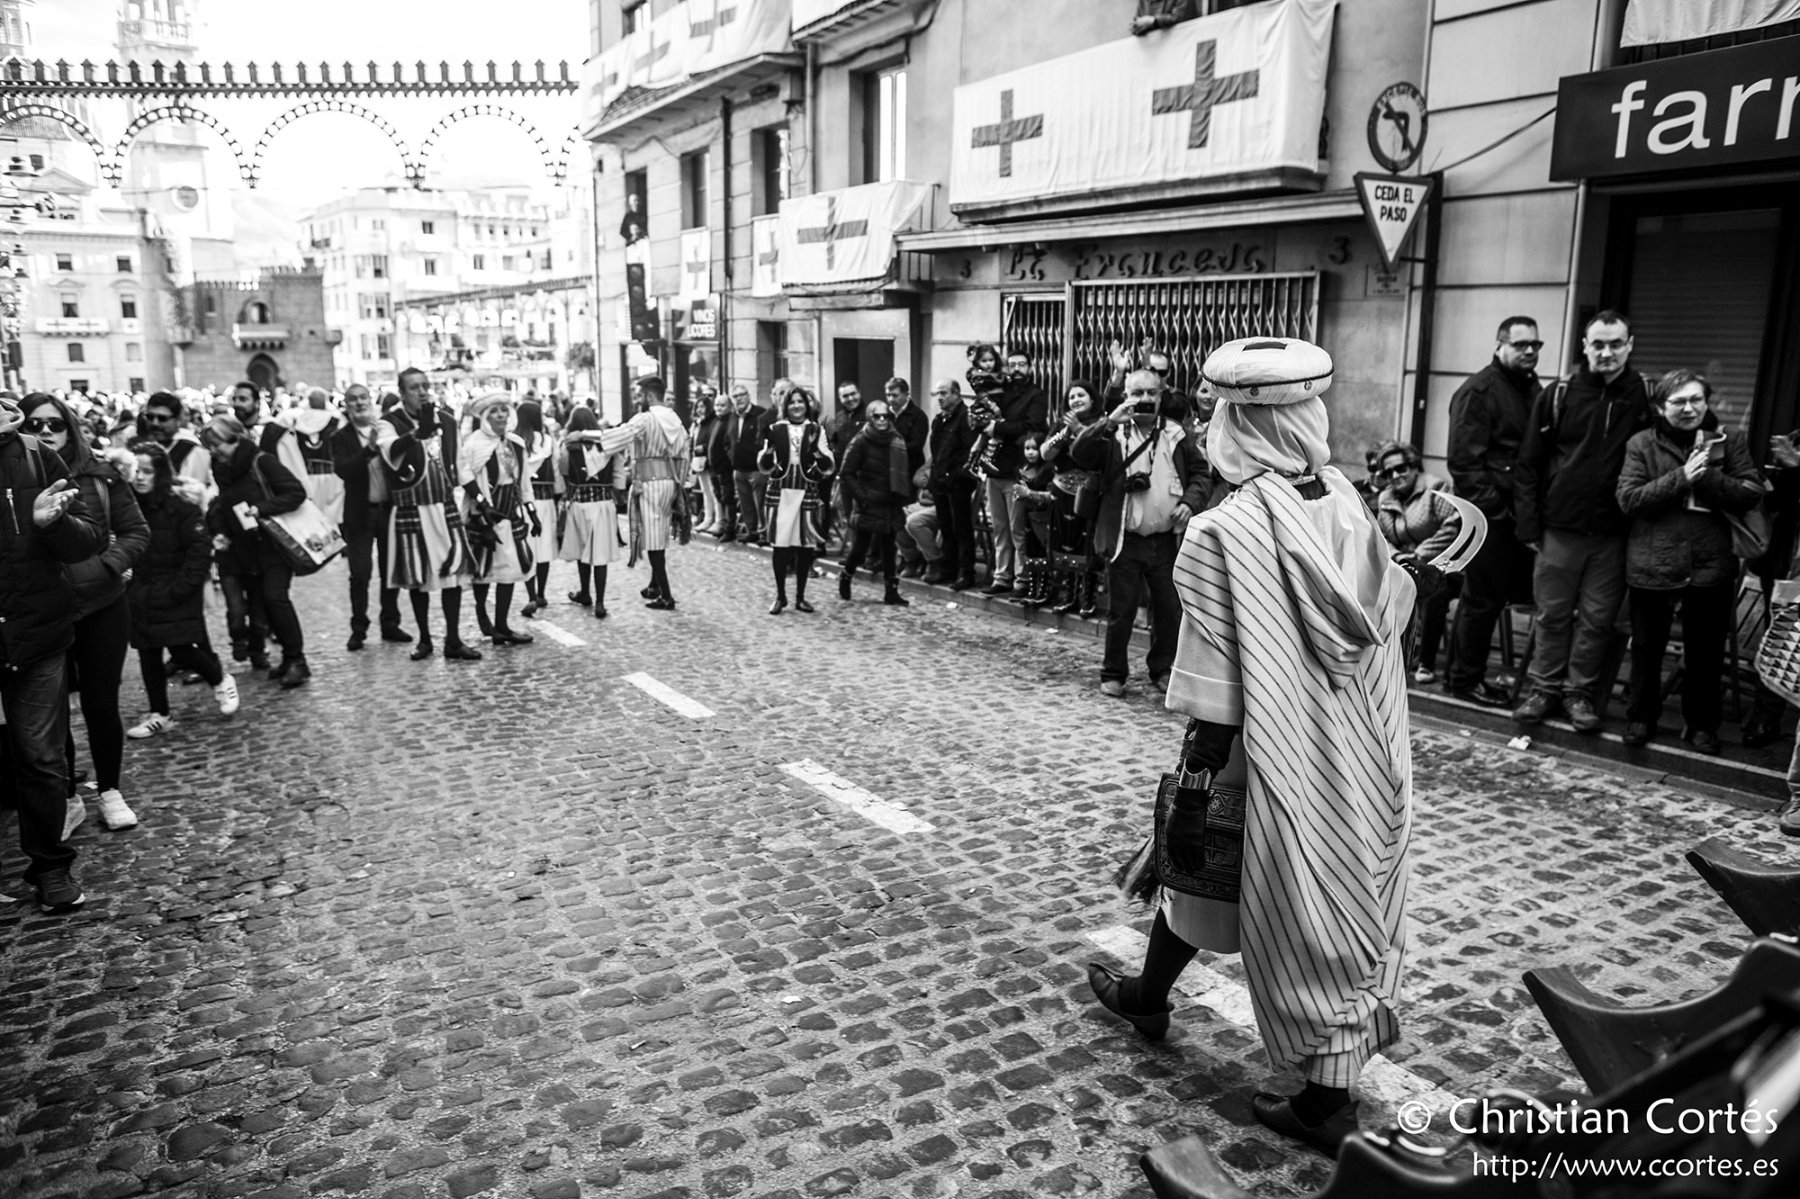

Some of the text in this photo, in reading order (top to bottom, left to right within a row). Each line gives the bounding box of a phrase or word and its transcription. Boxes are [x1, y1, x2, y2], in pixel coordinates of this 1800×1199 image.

[1374, 185, 1415, 203] CEDA EL
[1379, 205, 1407, 222] PASO
[1328, 235, 1350, 266] 3
